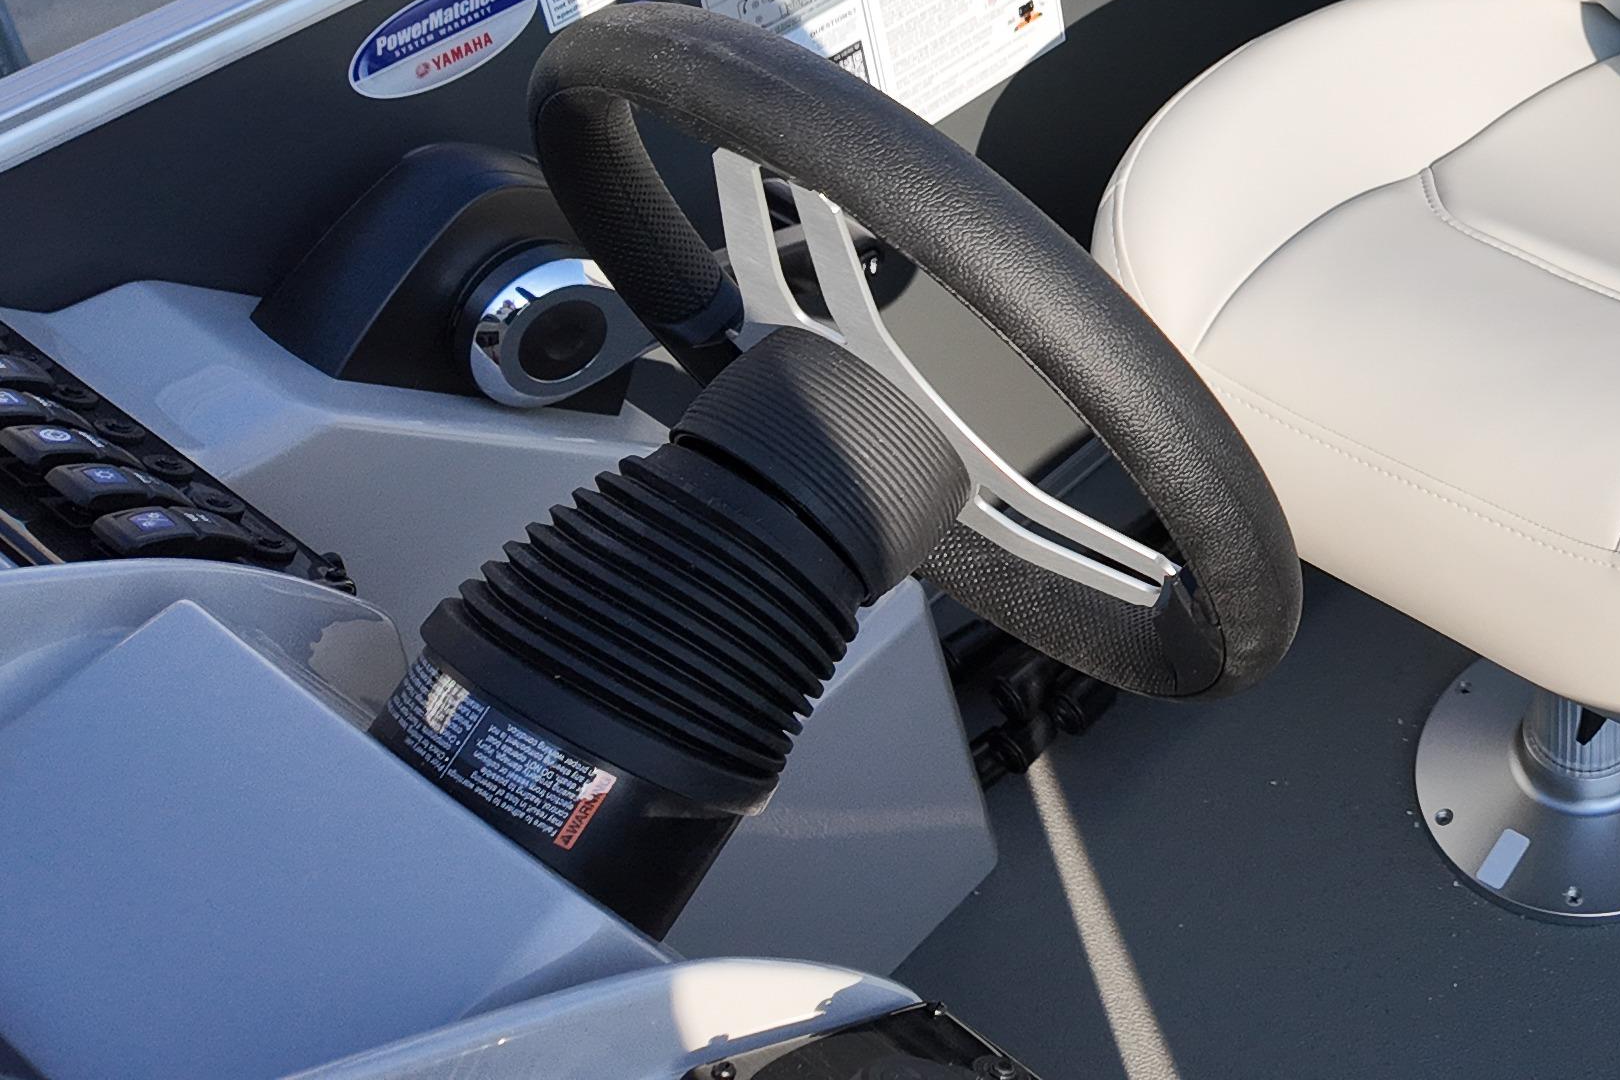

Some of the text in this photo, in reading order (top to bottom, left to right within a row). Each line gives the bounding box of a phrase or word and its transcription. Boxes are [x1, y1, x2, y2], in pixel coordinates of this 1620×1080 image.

[395, 5, 491, 57] SYSTEM WARRANTY
[432, 32, 492, 70] YAMAHA
[524, 758, 542, 772] NOT
[540, 767, 554, 779] DO
